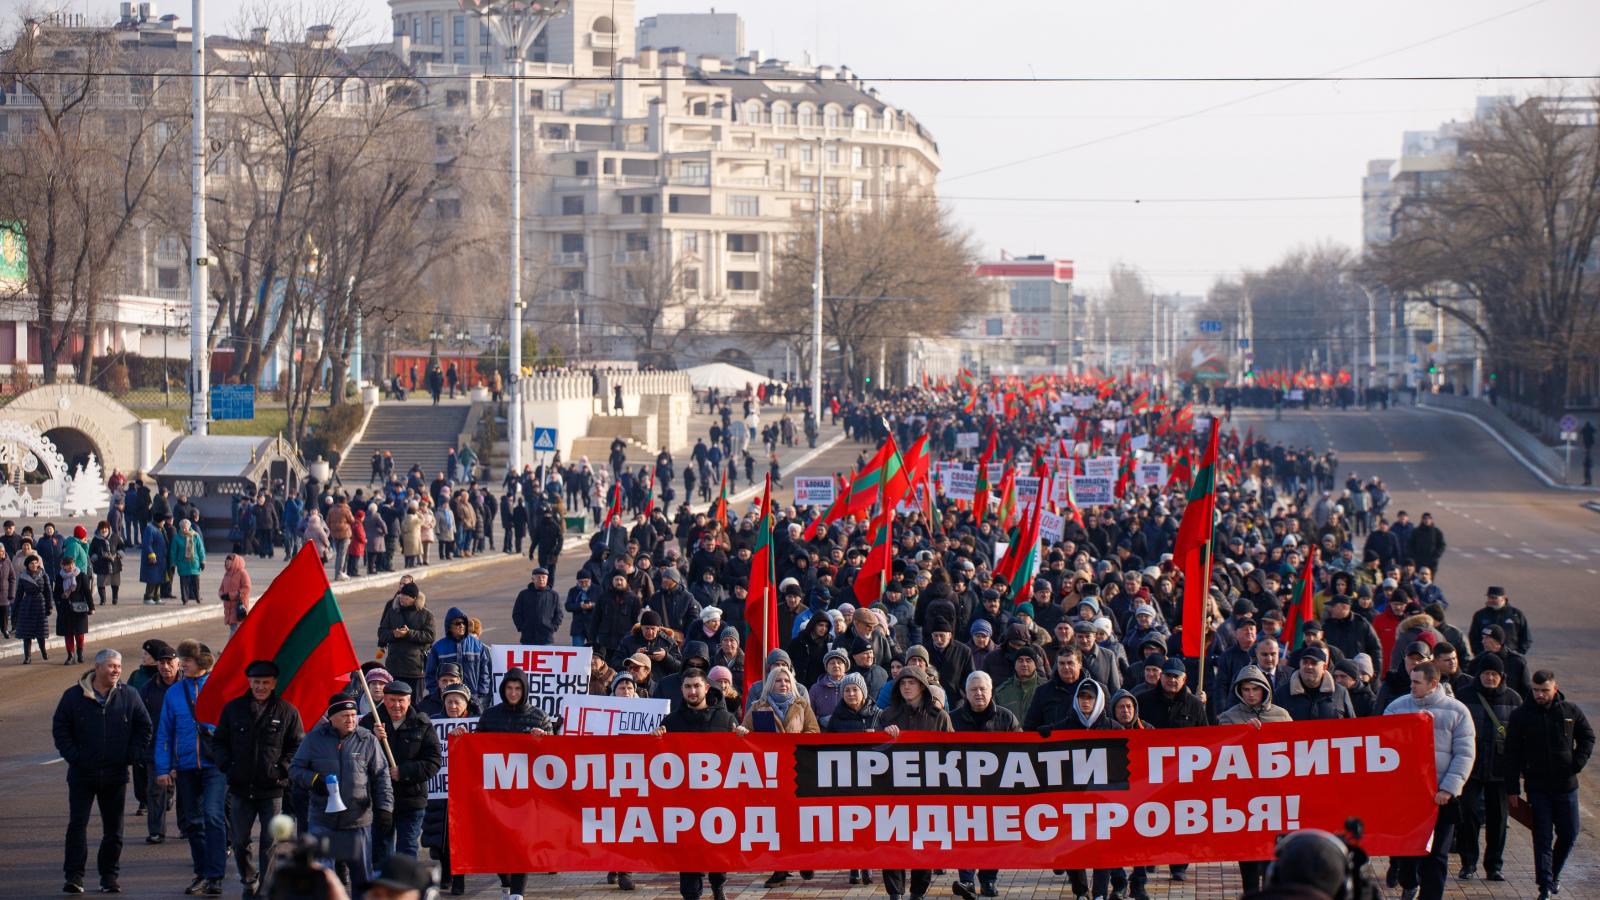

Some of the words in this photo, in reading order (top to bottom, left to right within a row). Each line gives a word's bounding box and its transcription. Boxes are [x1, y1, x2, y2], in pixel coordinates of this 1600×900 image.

[506, 650, 578, 673] НЕТ
[492, 672, 590, 695] ГБЕЖУ
[563, 706, 621, 736] НЕТ
[619, 711, 667, 732] БЛОКАД
[482, 751, 779, 797] МОЛДОВА!
[816, 748, 1108, 788] ПРЕКРАТИ
[1148, 735, 1400, 784] ГРАБИТЬ
[581, 806, 780, 852] НАРОД
[799, 795, 1301, 851] ПРИДНЕСТРОВЬЯ!
